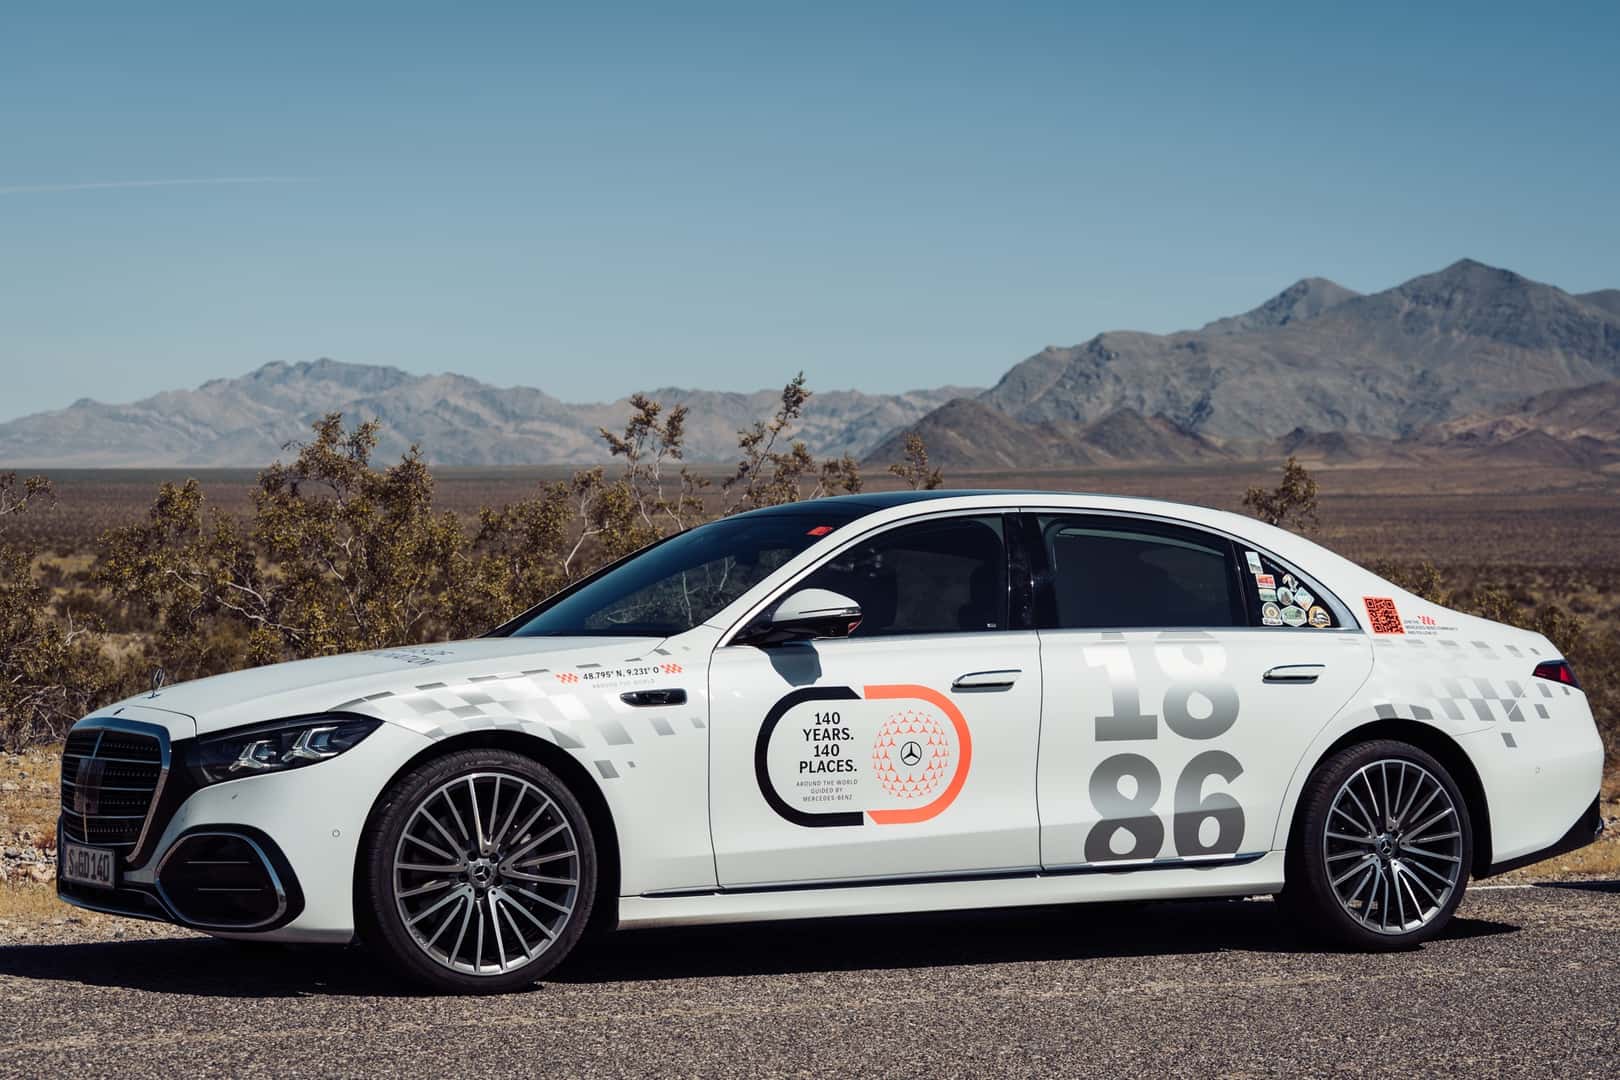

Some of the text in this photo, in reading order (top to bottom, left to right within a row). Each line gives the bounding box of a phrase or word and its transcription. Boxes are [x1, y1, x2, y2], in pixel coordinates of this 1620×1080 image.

[1082, 631, 1240, 742] 18
[815, 712, 841, 725] 140
[803, 728, 854, 742] YEARS.
[814, 744, 840, 758] 140
[799, 760, 858, 774] PLACES.
[1084, 749, 1246, 863] 86
